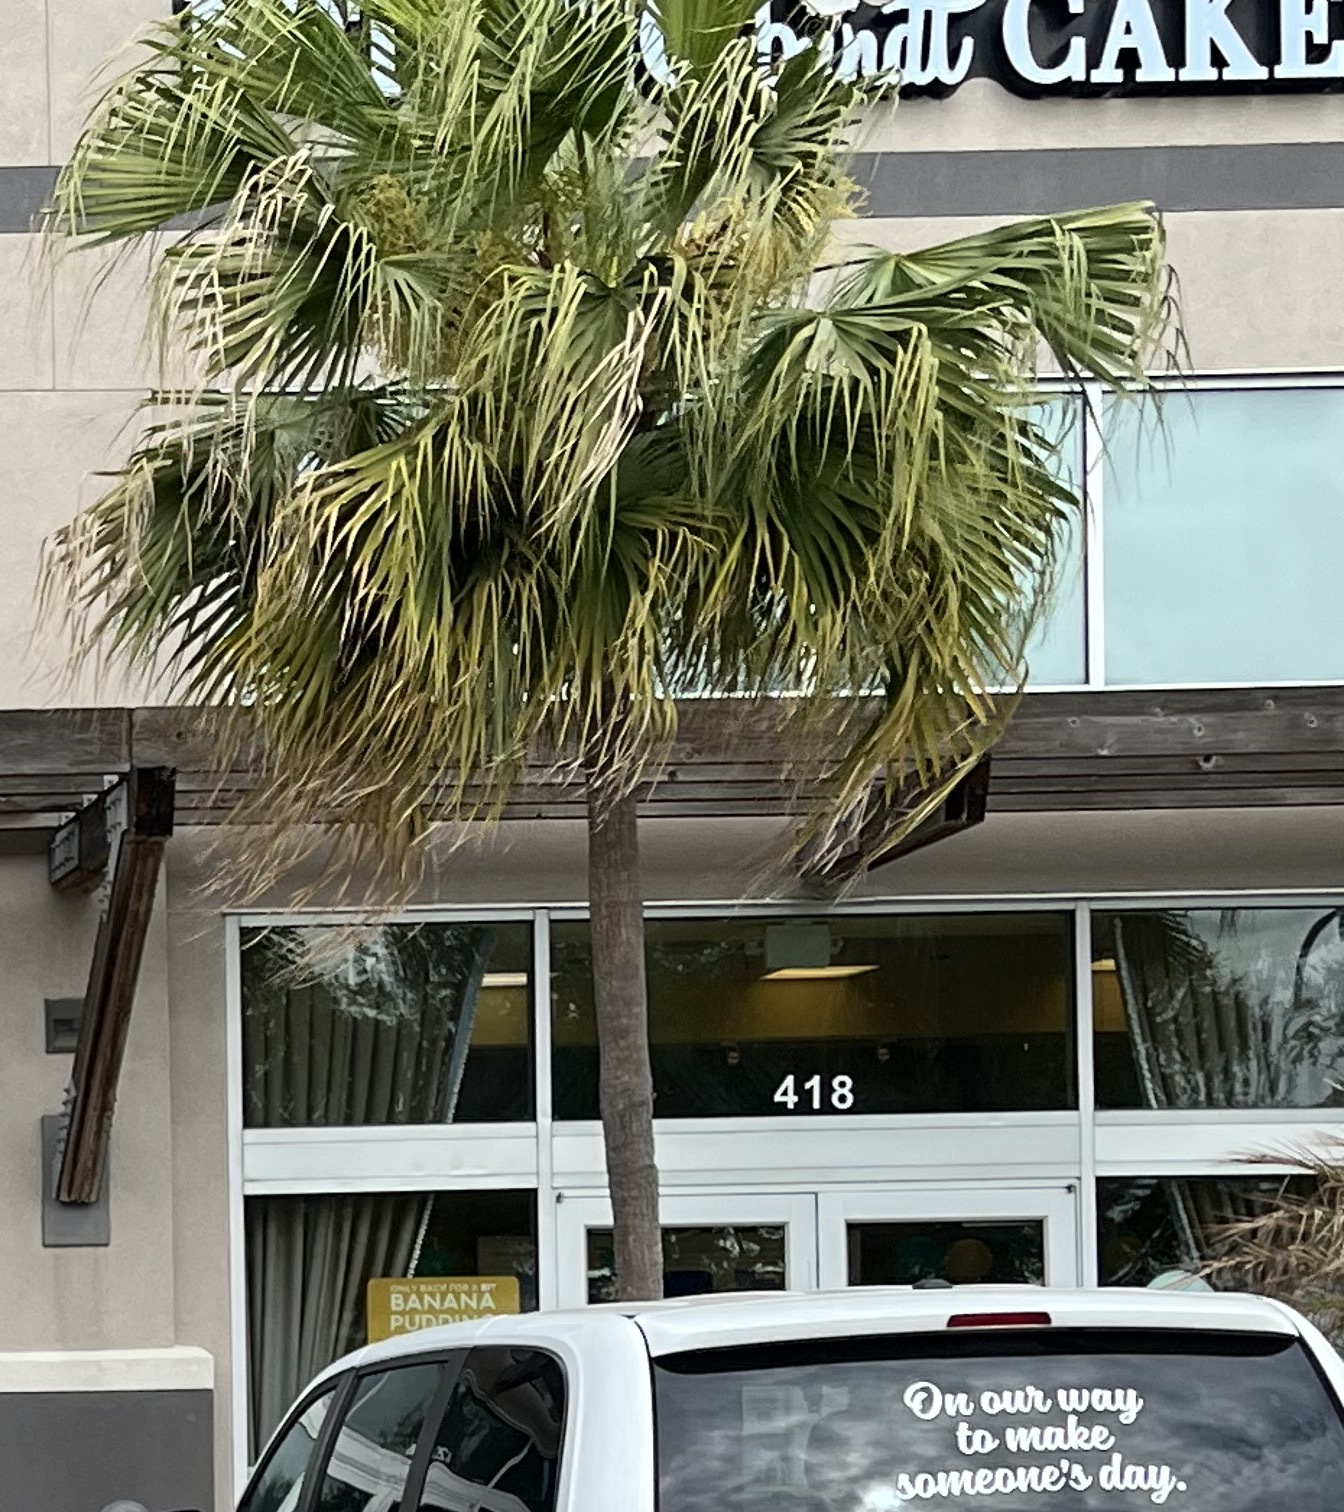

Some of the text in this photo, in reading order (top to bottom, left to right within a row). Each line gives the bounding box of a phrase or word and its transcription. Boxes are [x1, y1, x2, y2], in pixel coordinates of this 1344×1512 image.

[773, 1074, 854, 1109] 418
[390, 1293, 496, 1311] BANANA
[904, 1381, 1144, 1424] On our way
[956, 1414, 1115, 1454] to make
[896, 1452, 1187, 1504] someone's day.
